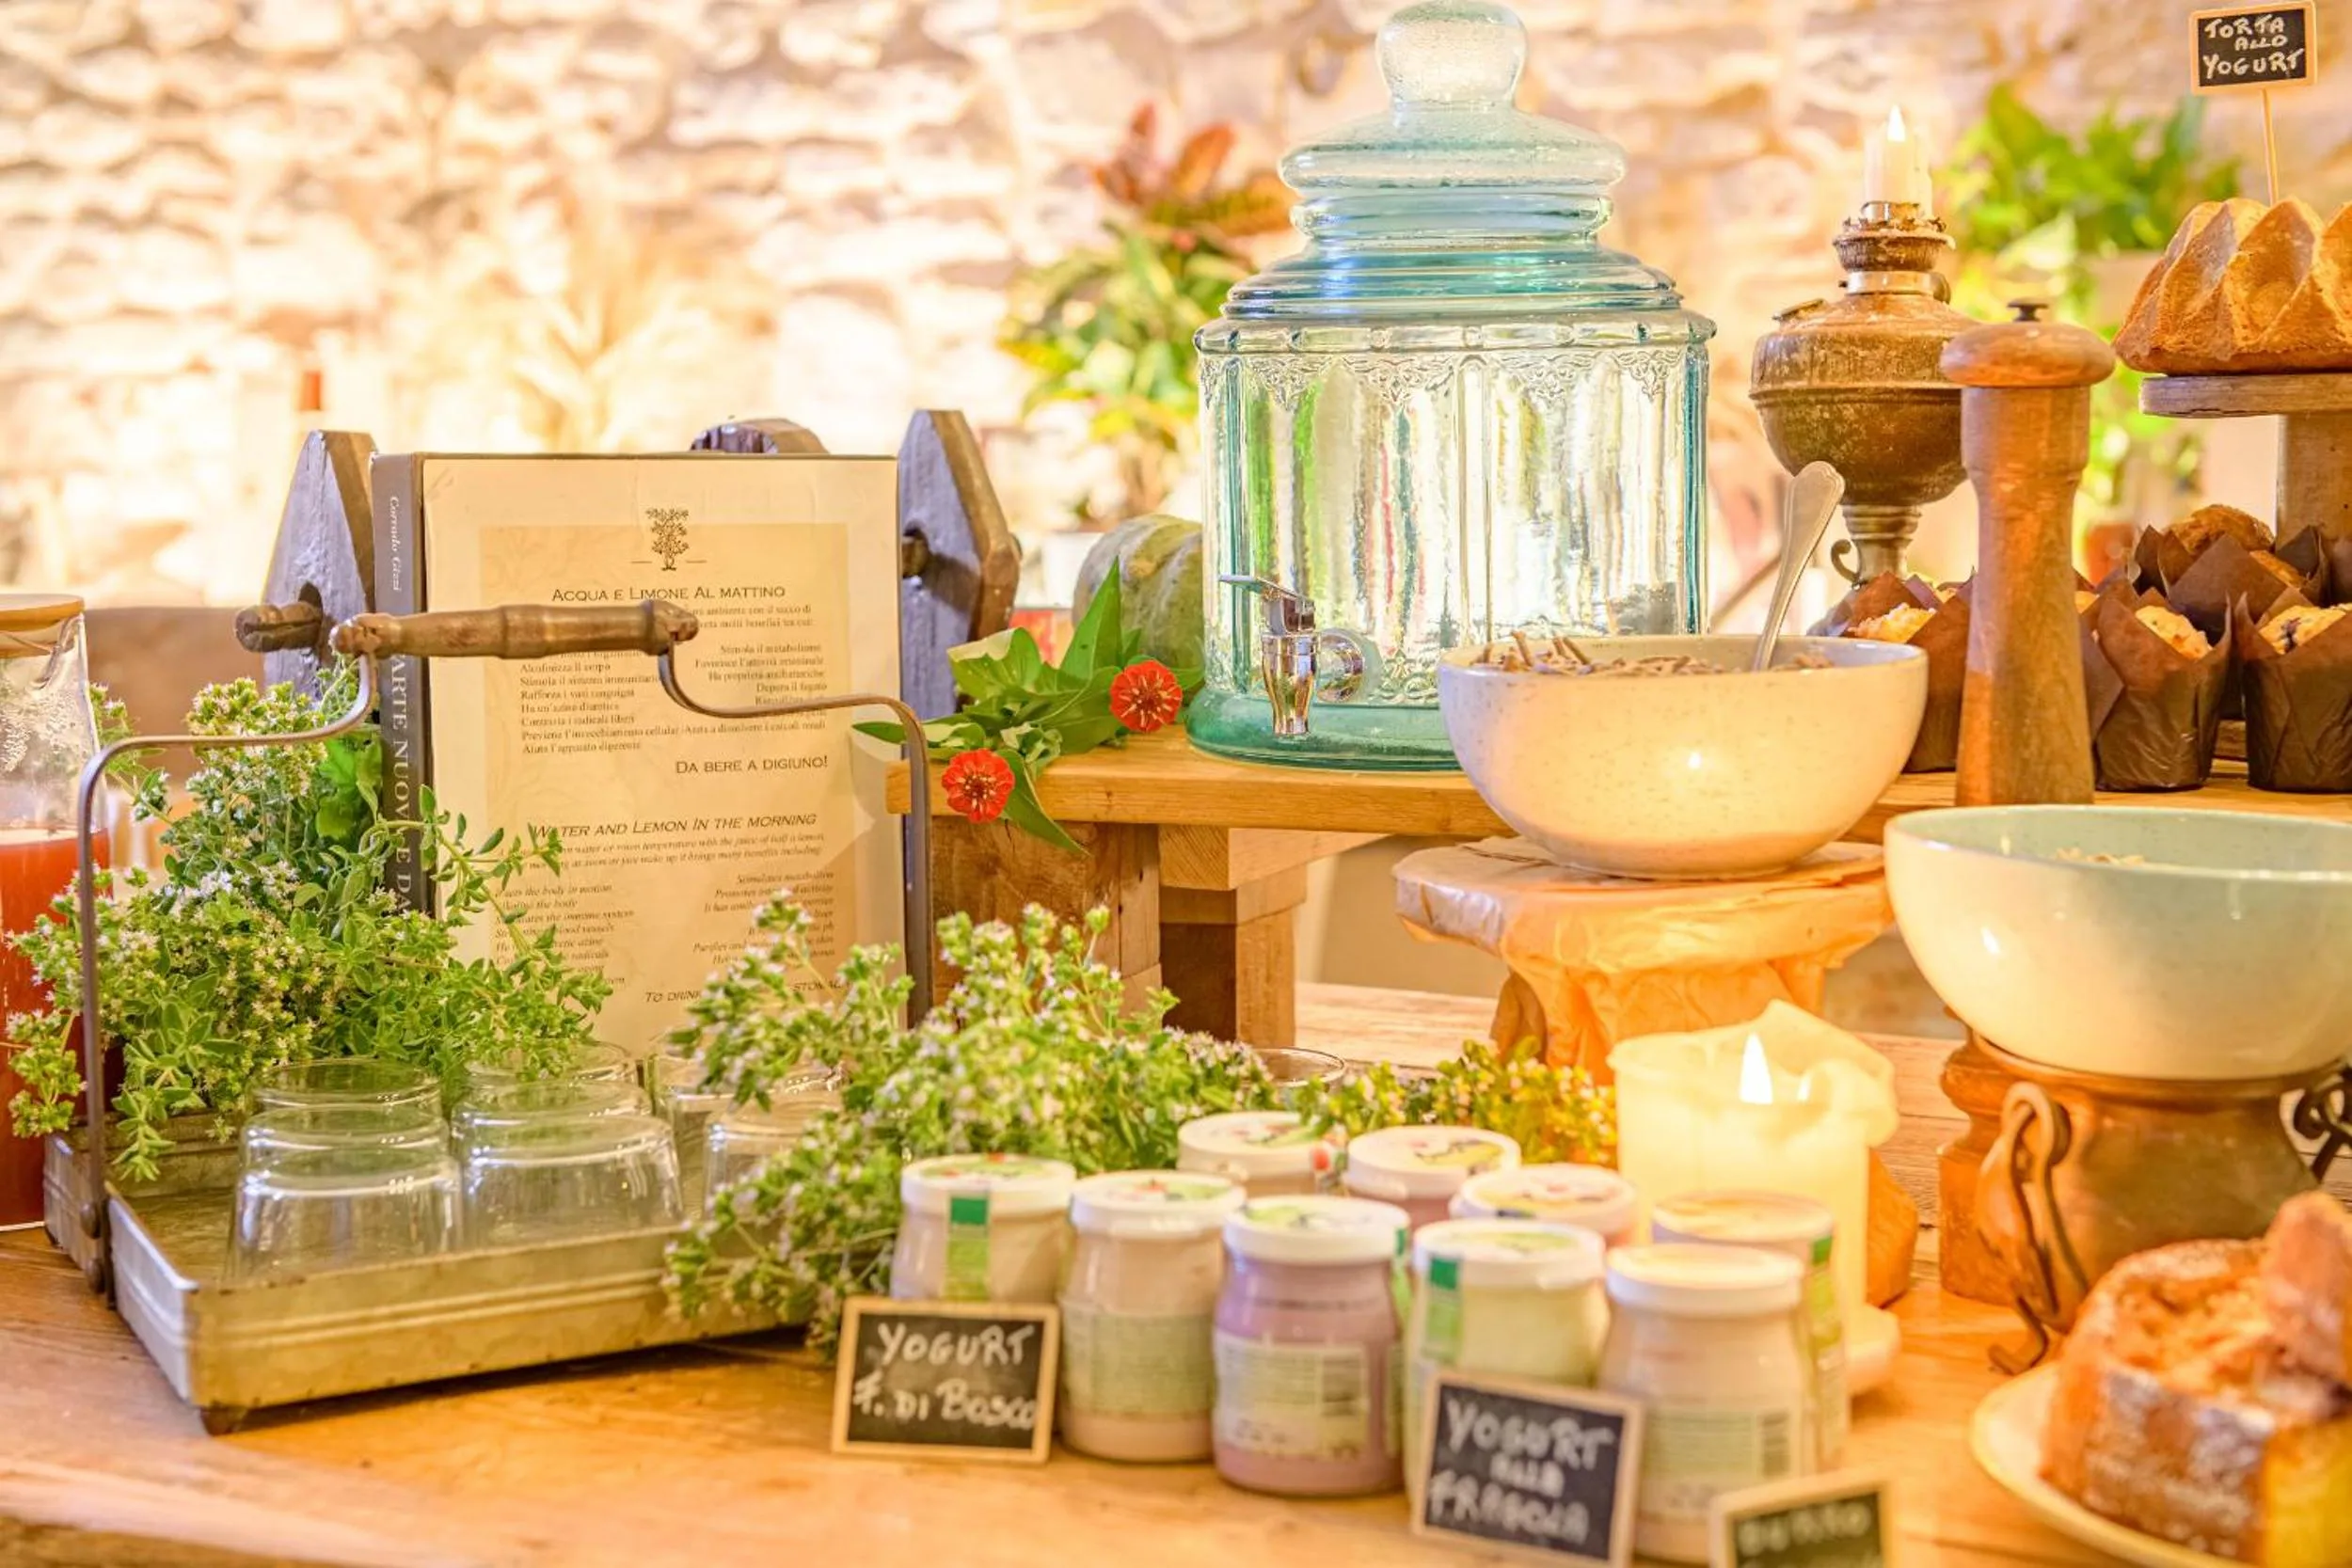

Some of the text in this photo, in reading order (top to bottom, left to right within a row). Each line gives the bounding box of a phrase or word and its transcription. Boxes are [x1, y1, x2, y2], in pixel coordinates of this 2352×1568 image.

[2203, 13, 2285, 39] TORTA
[2234, 34, 2288, 51] ALLO
[2202, 48, 2304, 79] YOGURT
[389, 496, 402, 552] Corrado
[551, 587, 787, 602] ACQUA E LIMONE AL MATTINO
[675, 755, 828, 774] DA BERE A DIGIUNO!
[534, 813, 818, 837] WTER AND LEMON IN THE MORNING
[877, 1322, 1035, 1366] YOGURT
[1446, 1399, 1616, 1471] YOGURT
